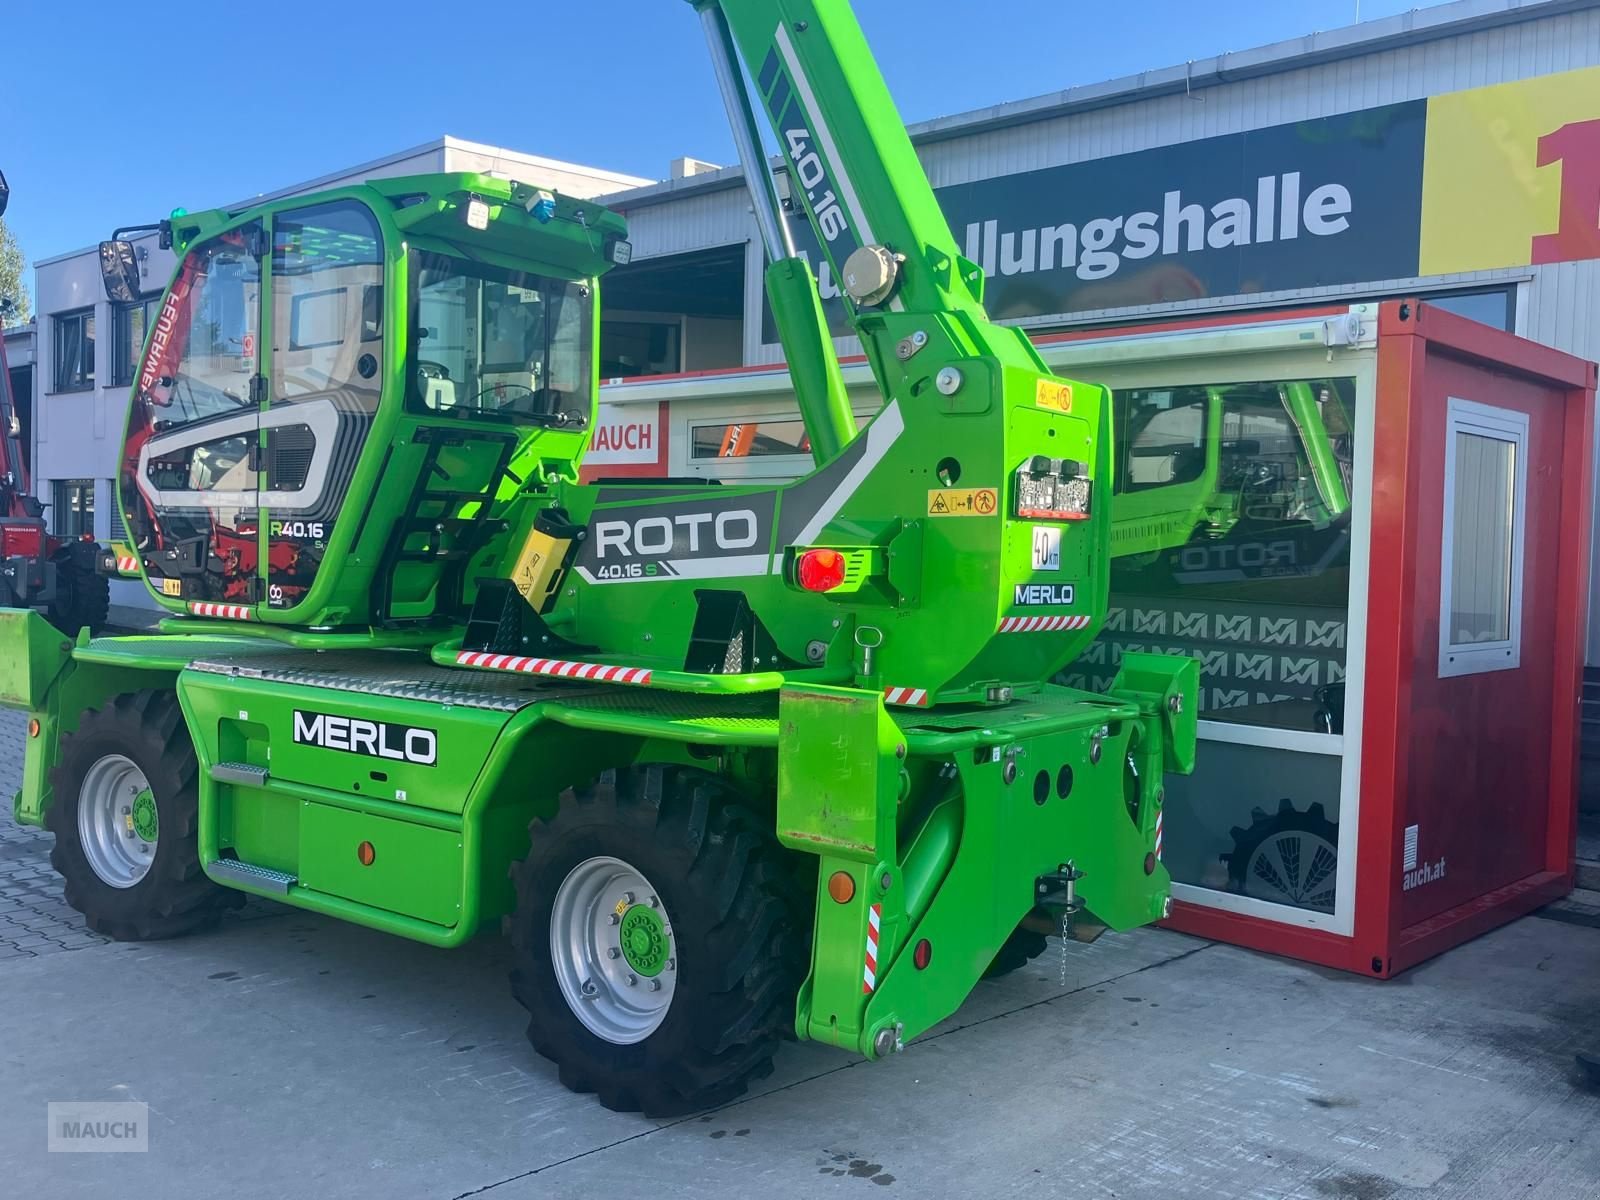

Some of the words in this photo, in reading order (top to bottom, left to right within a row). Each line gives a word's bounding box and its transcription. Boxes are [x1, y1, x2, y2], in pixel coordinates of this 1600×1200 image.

[785, 128, 848, 242] 40.16
[270, 521, 324, 538] R40.16
[595, 509, 757, 558] ROTO
[1034, 531, 1048, 565] 40
[598, 563, 642, 579] 40.16
[645, 563, 657, 576] S
[1015, 585, 1073, 604] MERLO
[294, 711, 436, 764] MERLO
